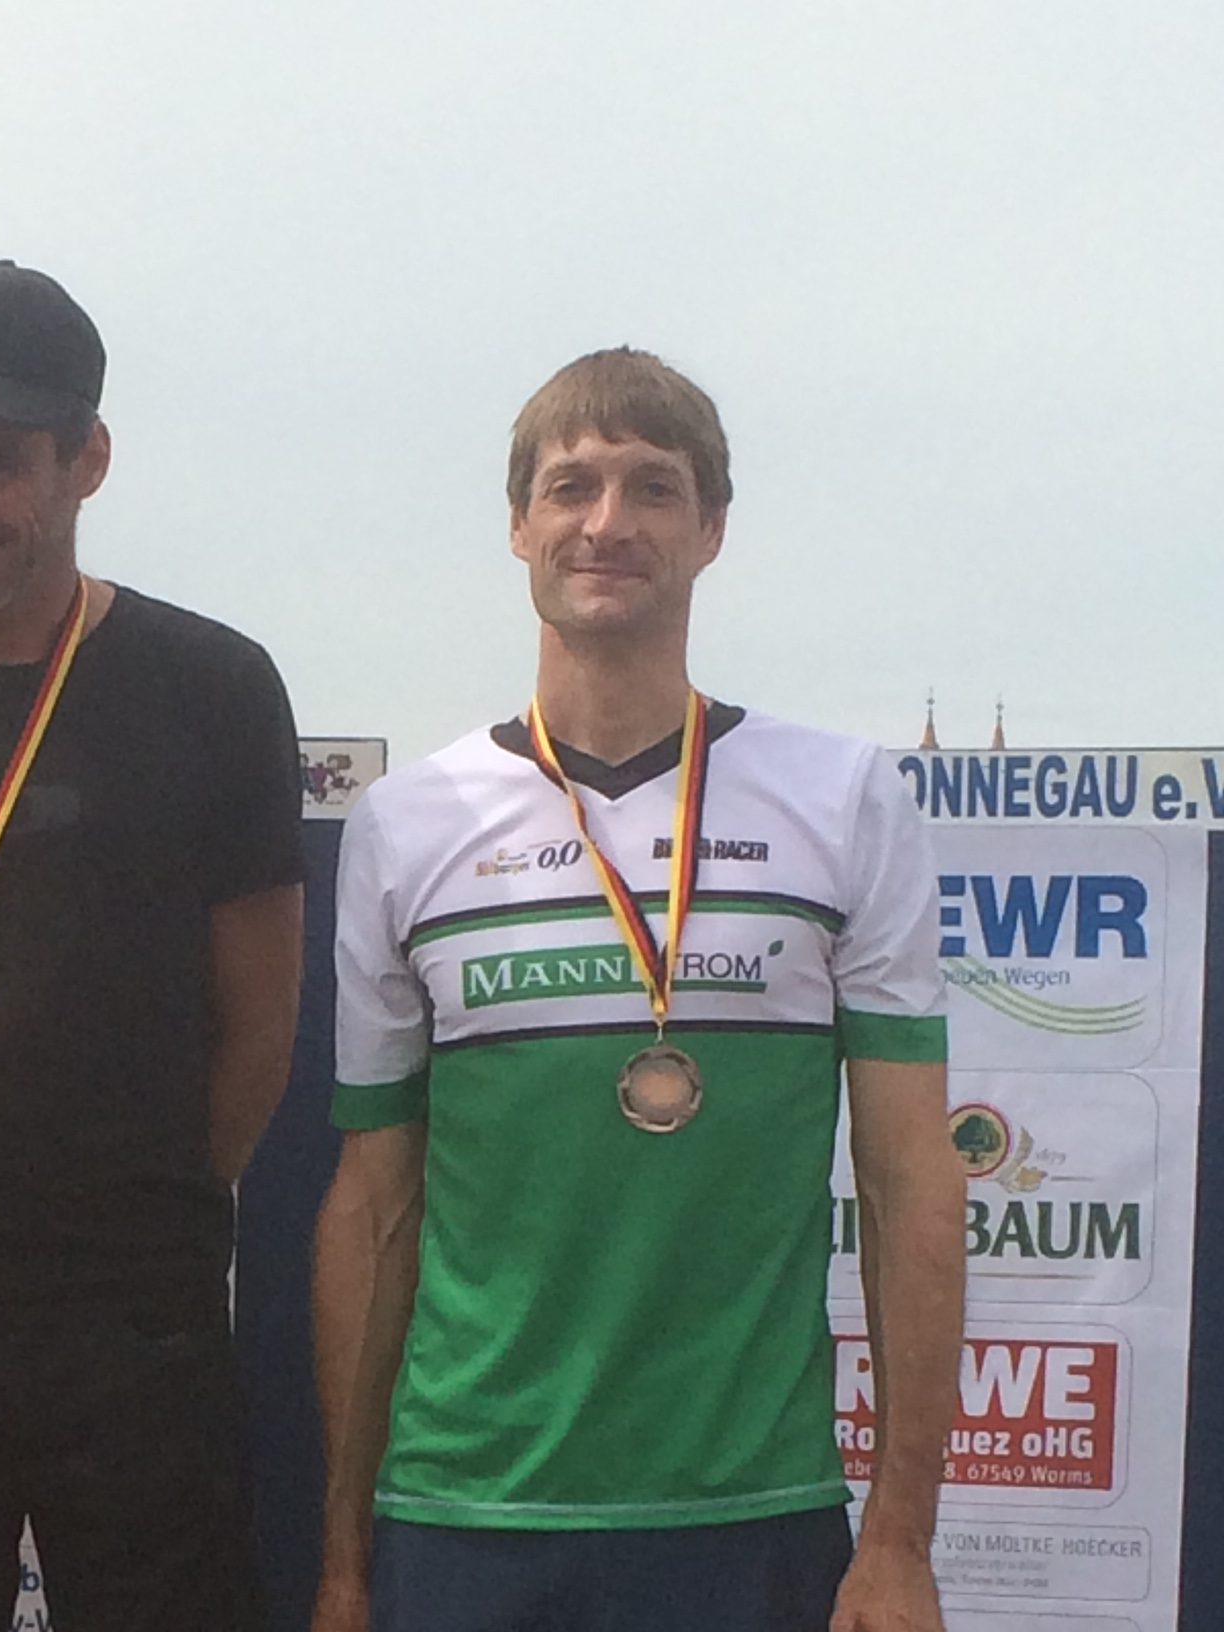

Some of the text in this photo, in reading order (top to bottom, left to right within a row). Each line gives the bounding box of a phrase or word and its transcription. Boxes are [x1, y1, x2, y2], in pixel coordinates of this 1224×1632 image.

[898, 755, 1137, 819] ONNEGAU
[939, 875, 1149, 959] EWR
[677, 951, 763, 981] ROM
[1004, 966, 1071, 990] Wegen
[1021, 1427, 1094, 1459] oHG
[967, 1463, 1026, 1483] 67549
[1031, 1465, 1093, 1485] Worms
[943, 1533, 980, 1551] VON
